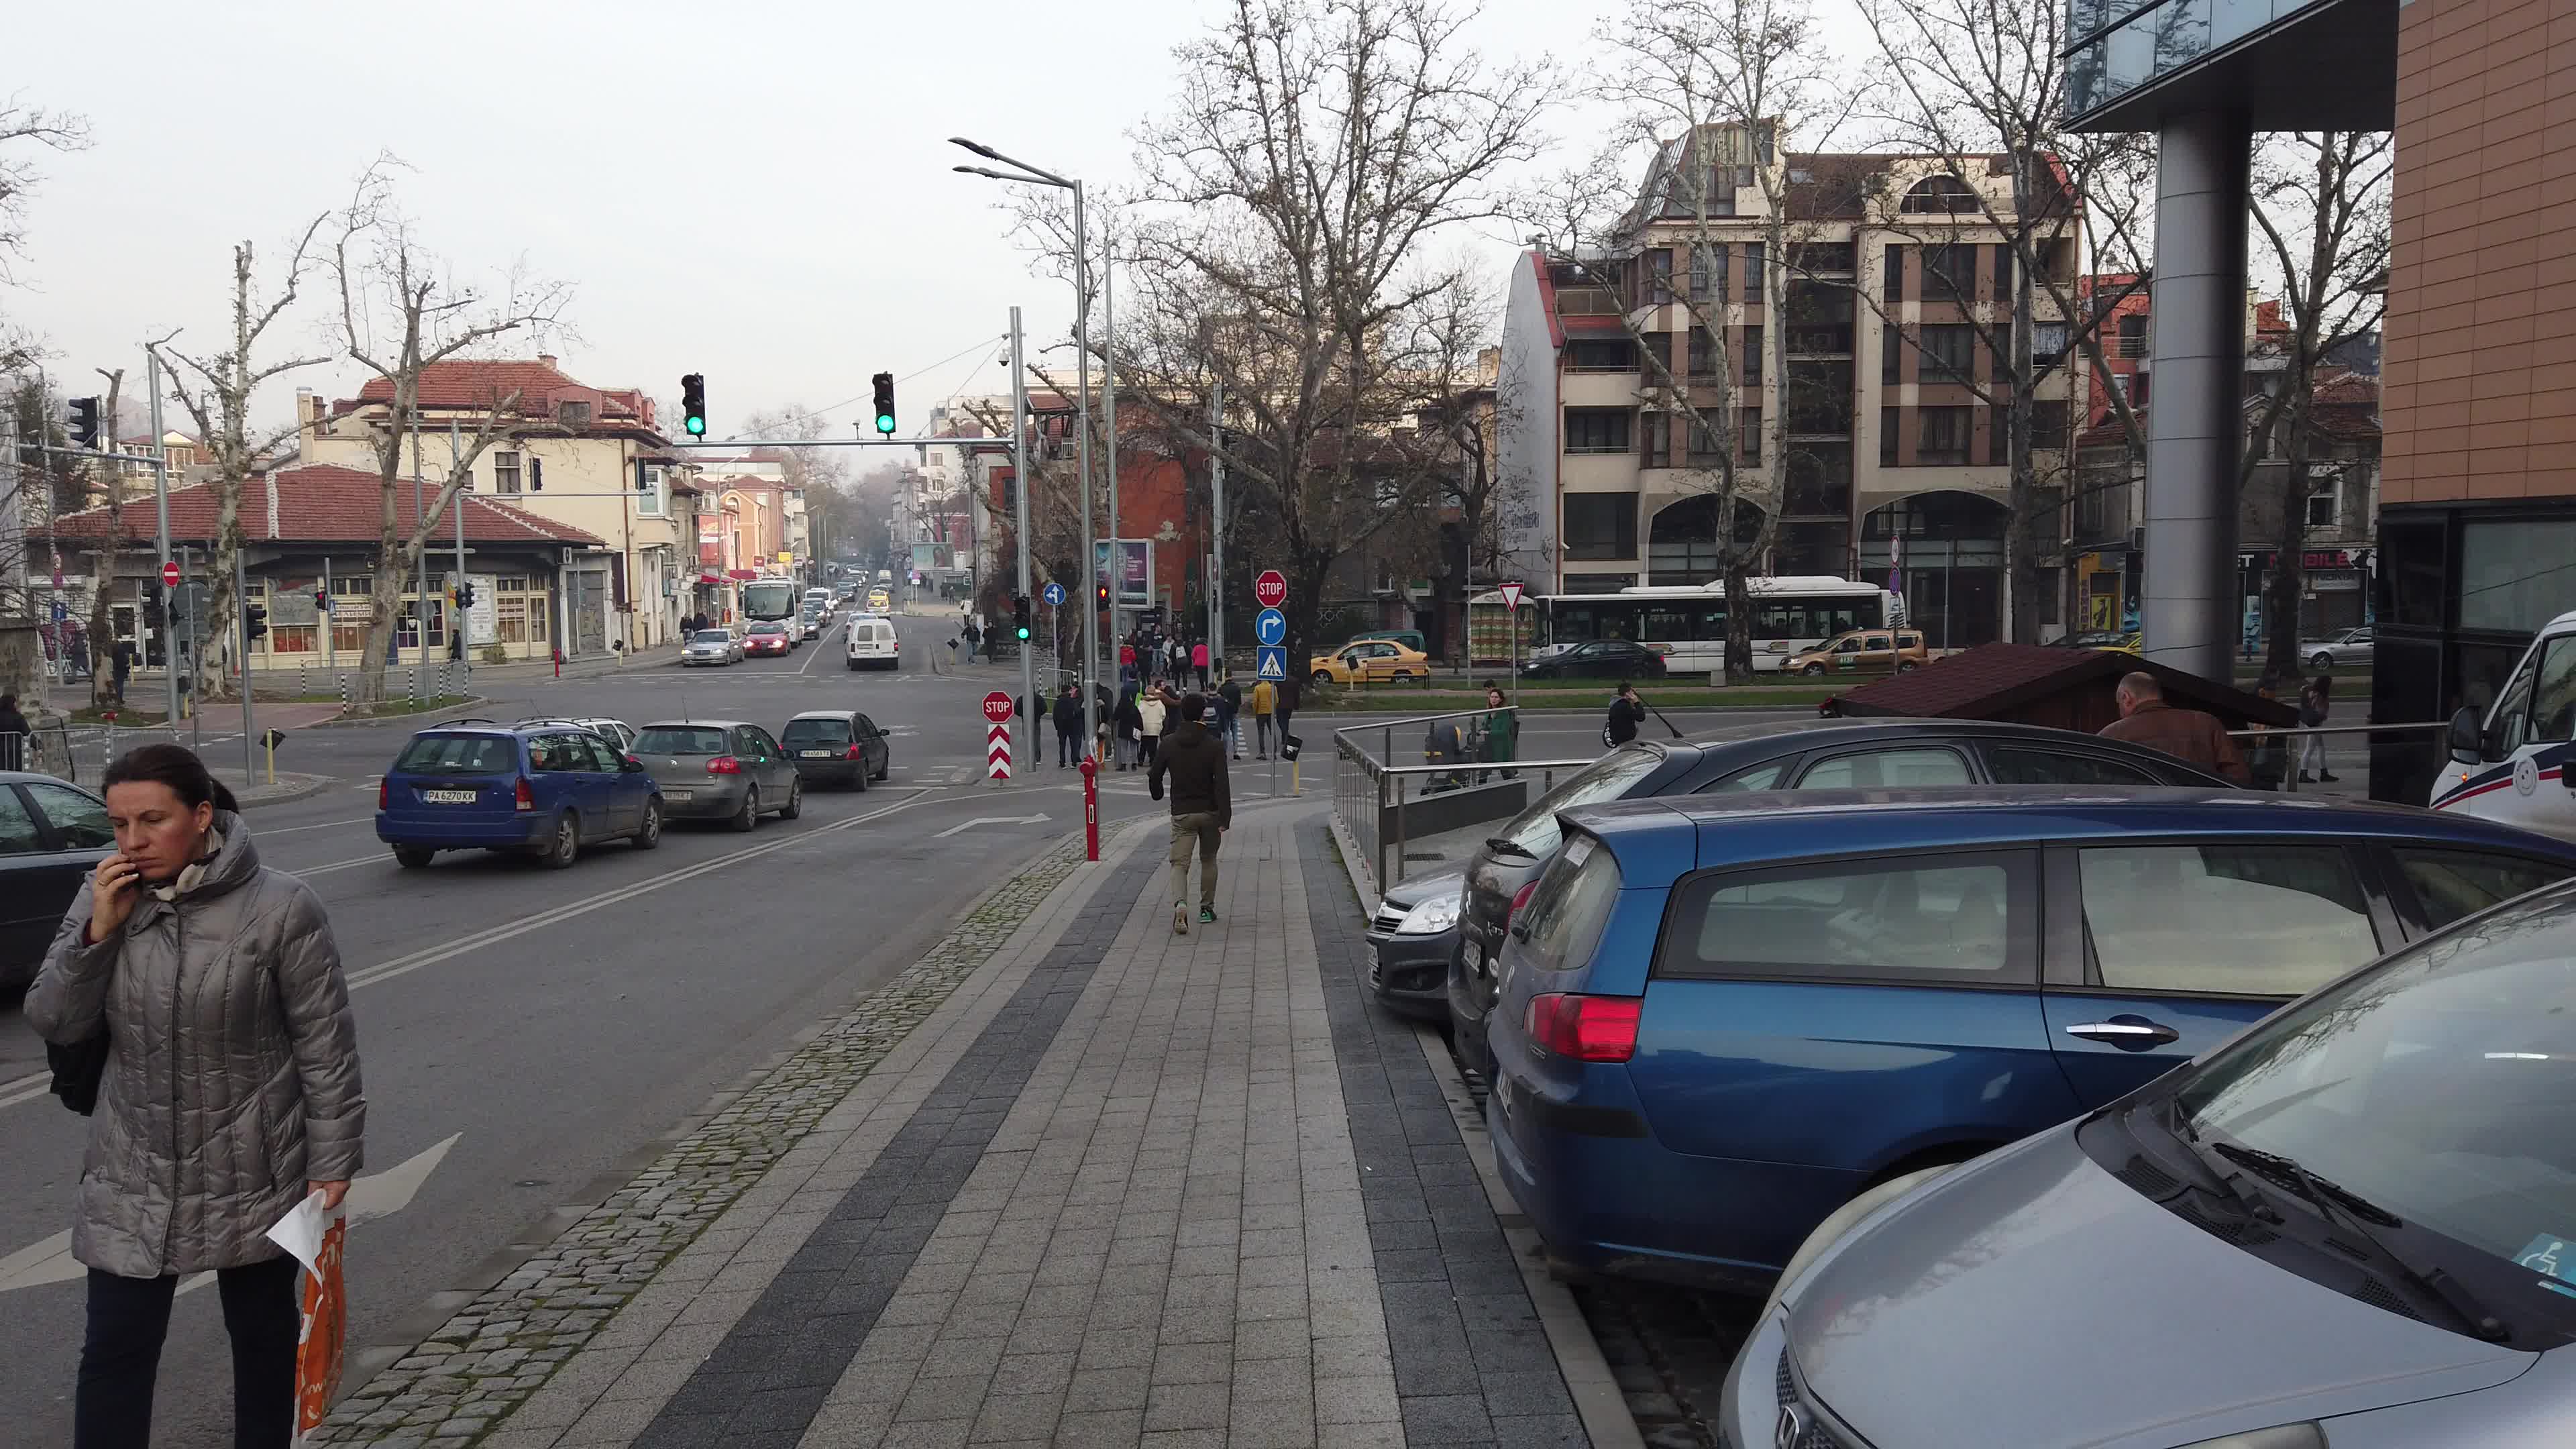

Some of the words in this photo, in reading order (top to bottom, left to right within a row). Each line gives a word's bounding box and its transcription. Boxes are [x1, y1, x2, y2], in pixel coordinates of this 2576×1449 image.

[1259, 582, 1283, 595] STOP
[985, 701, 1010, 713] STOP
[441, 792, 462, 800] 6270
